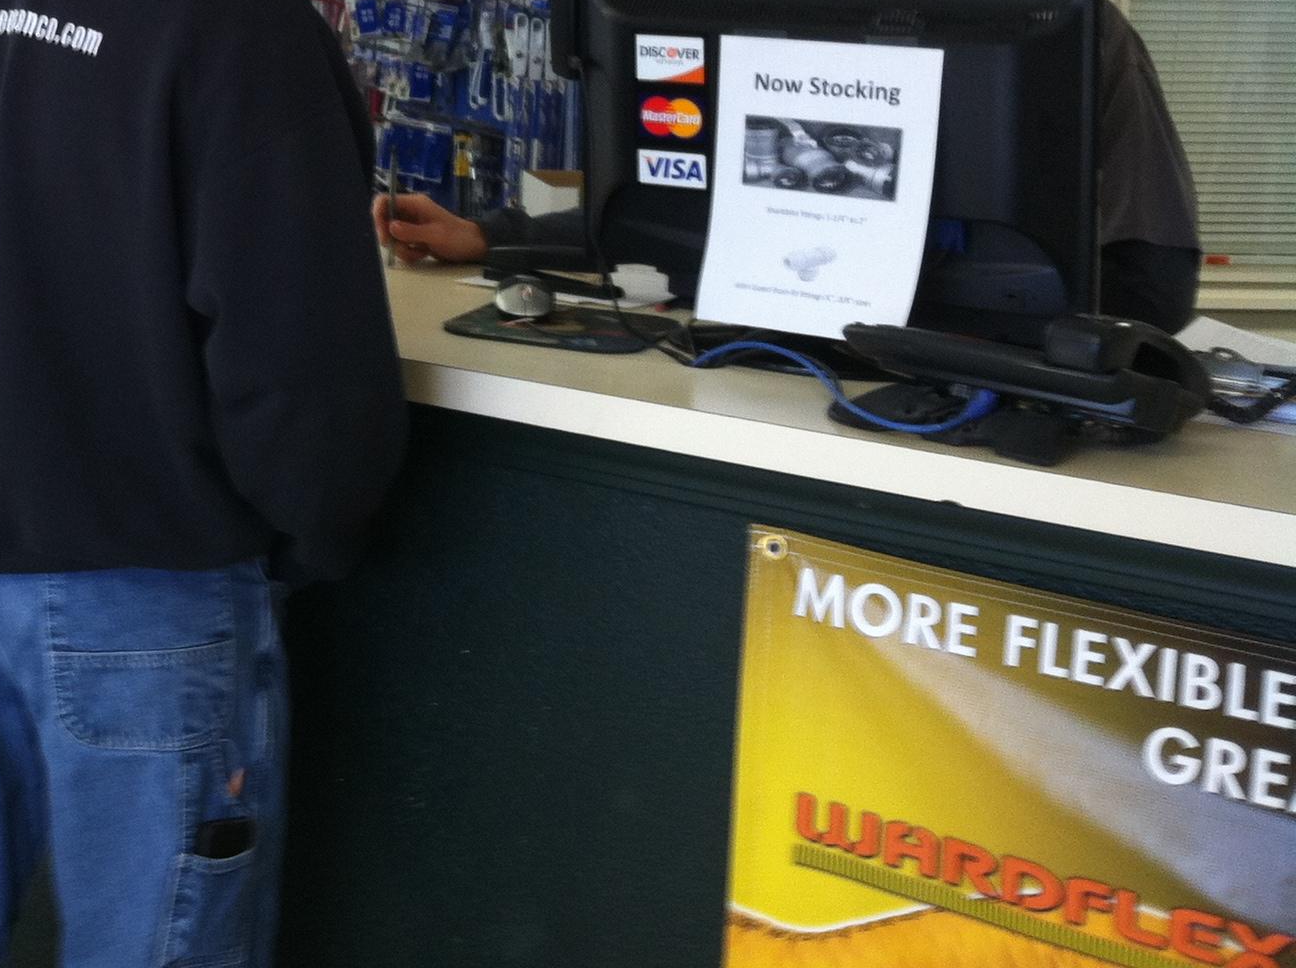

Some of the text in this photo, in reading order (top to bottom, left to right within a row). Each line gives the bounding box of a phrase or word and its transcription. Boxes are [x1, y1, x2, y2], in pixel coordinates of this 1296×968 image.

[639, 45, 700, 60] DISCOVER
[754, 73, 901, 106] Now Stocking
[640, 109, 702, 126] MasterCard
[643, 154, 704, 182] VISA
[793, 568, 1296, 730] MORE FLEXIBLE
[1141, 727, 1296, 813] GRE
